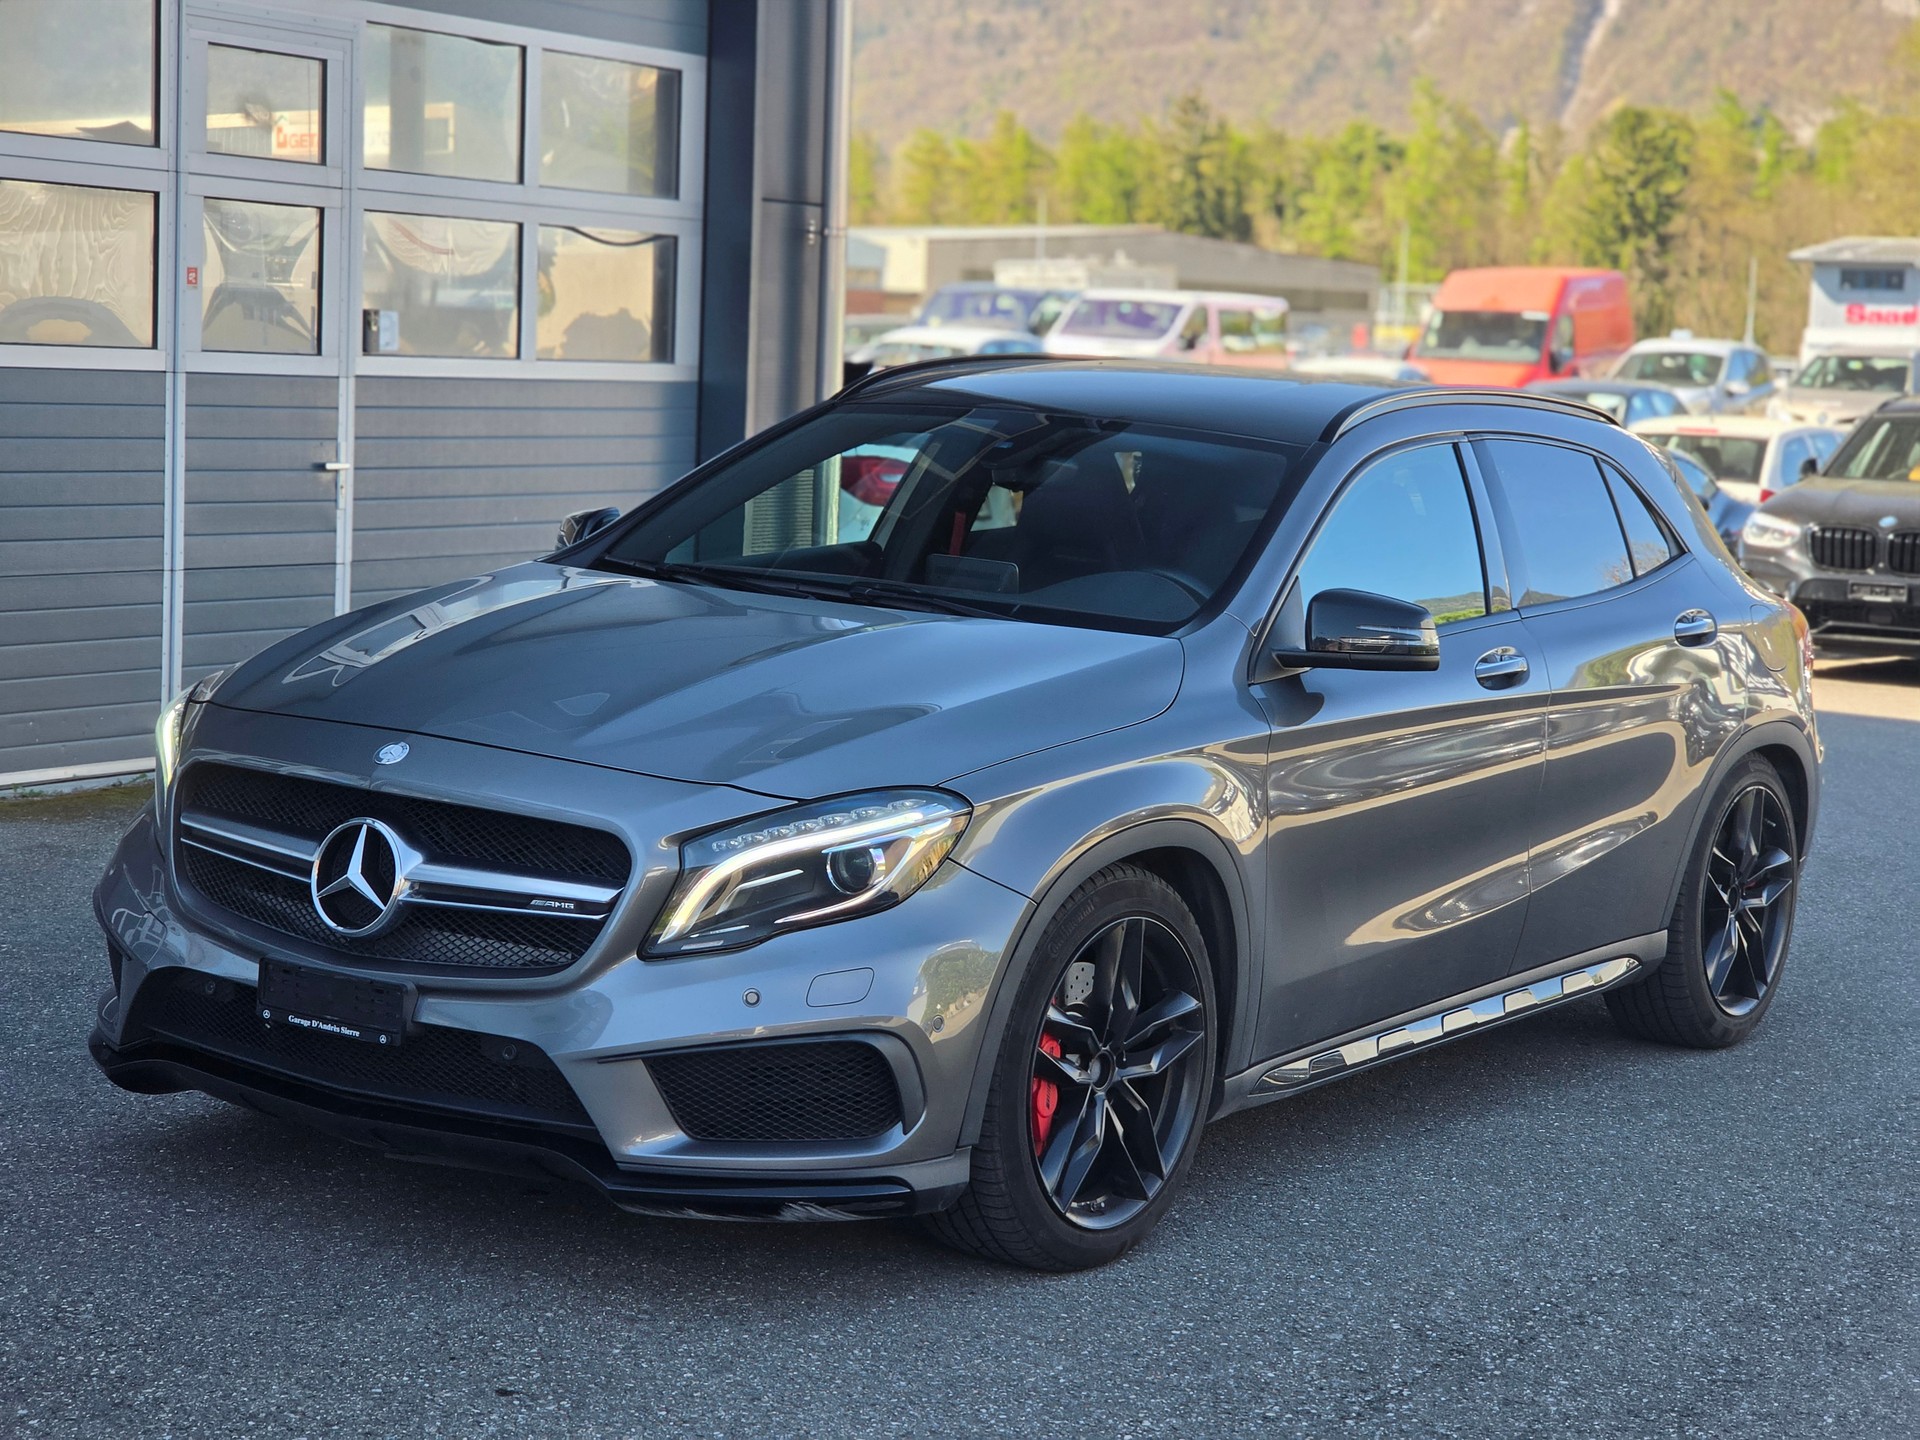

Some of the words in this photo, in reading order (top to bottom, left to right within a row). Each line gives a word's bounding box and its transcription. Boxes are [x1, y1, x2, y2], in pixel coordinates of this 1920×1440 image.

[543, 900, 575, 909] AMG
[288, 1015, 311, 1027] Garage
[340, 1026, 360, 1037] Sierre
